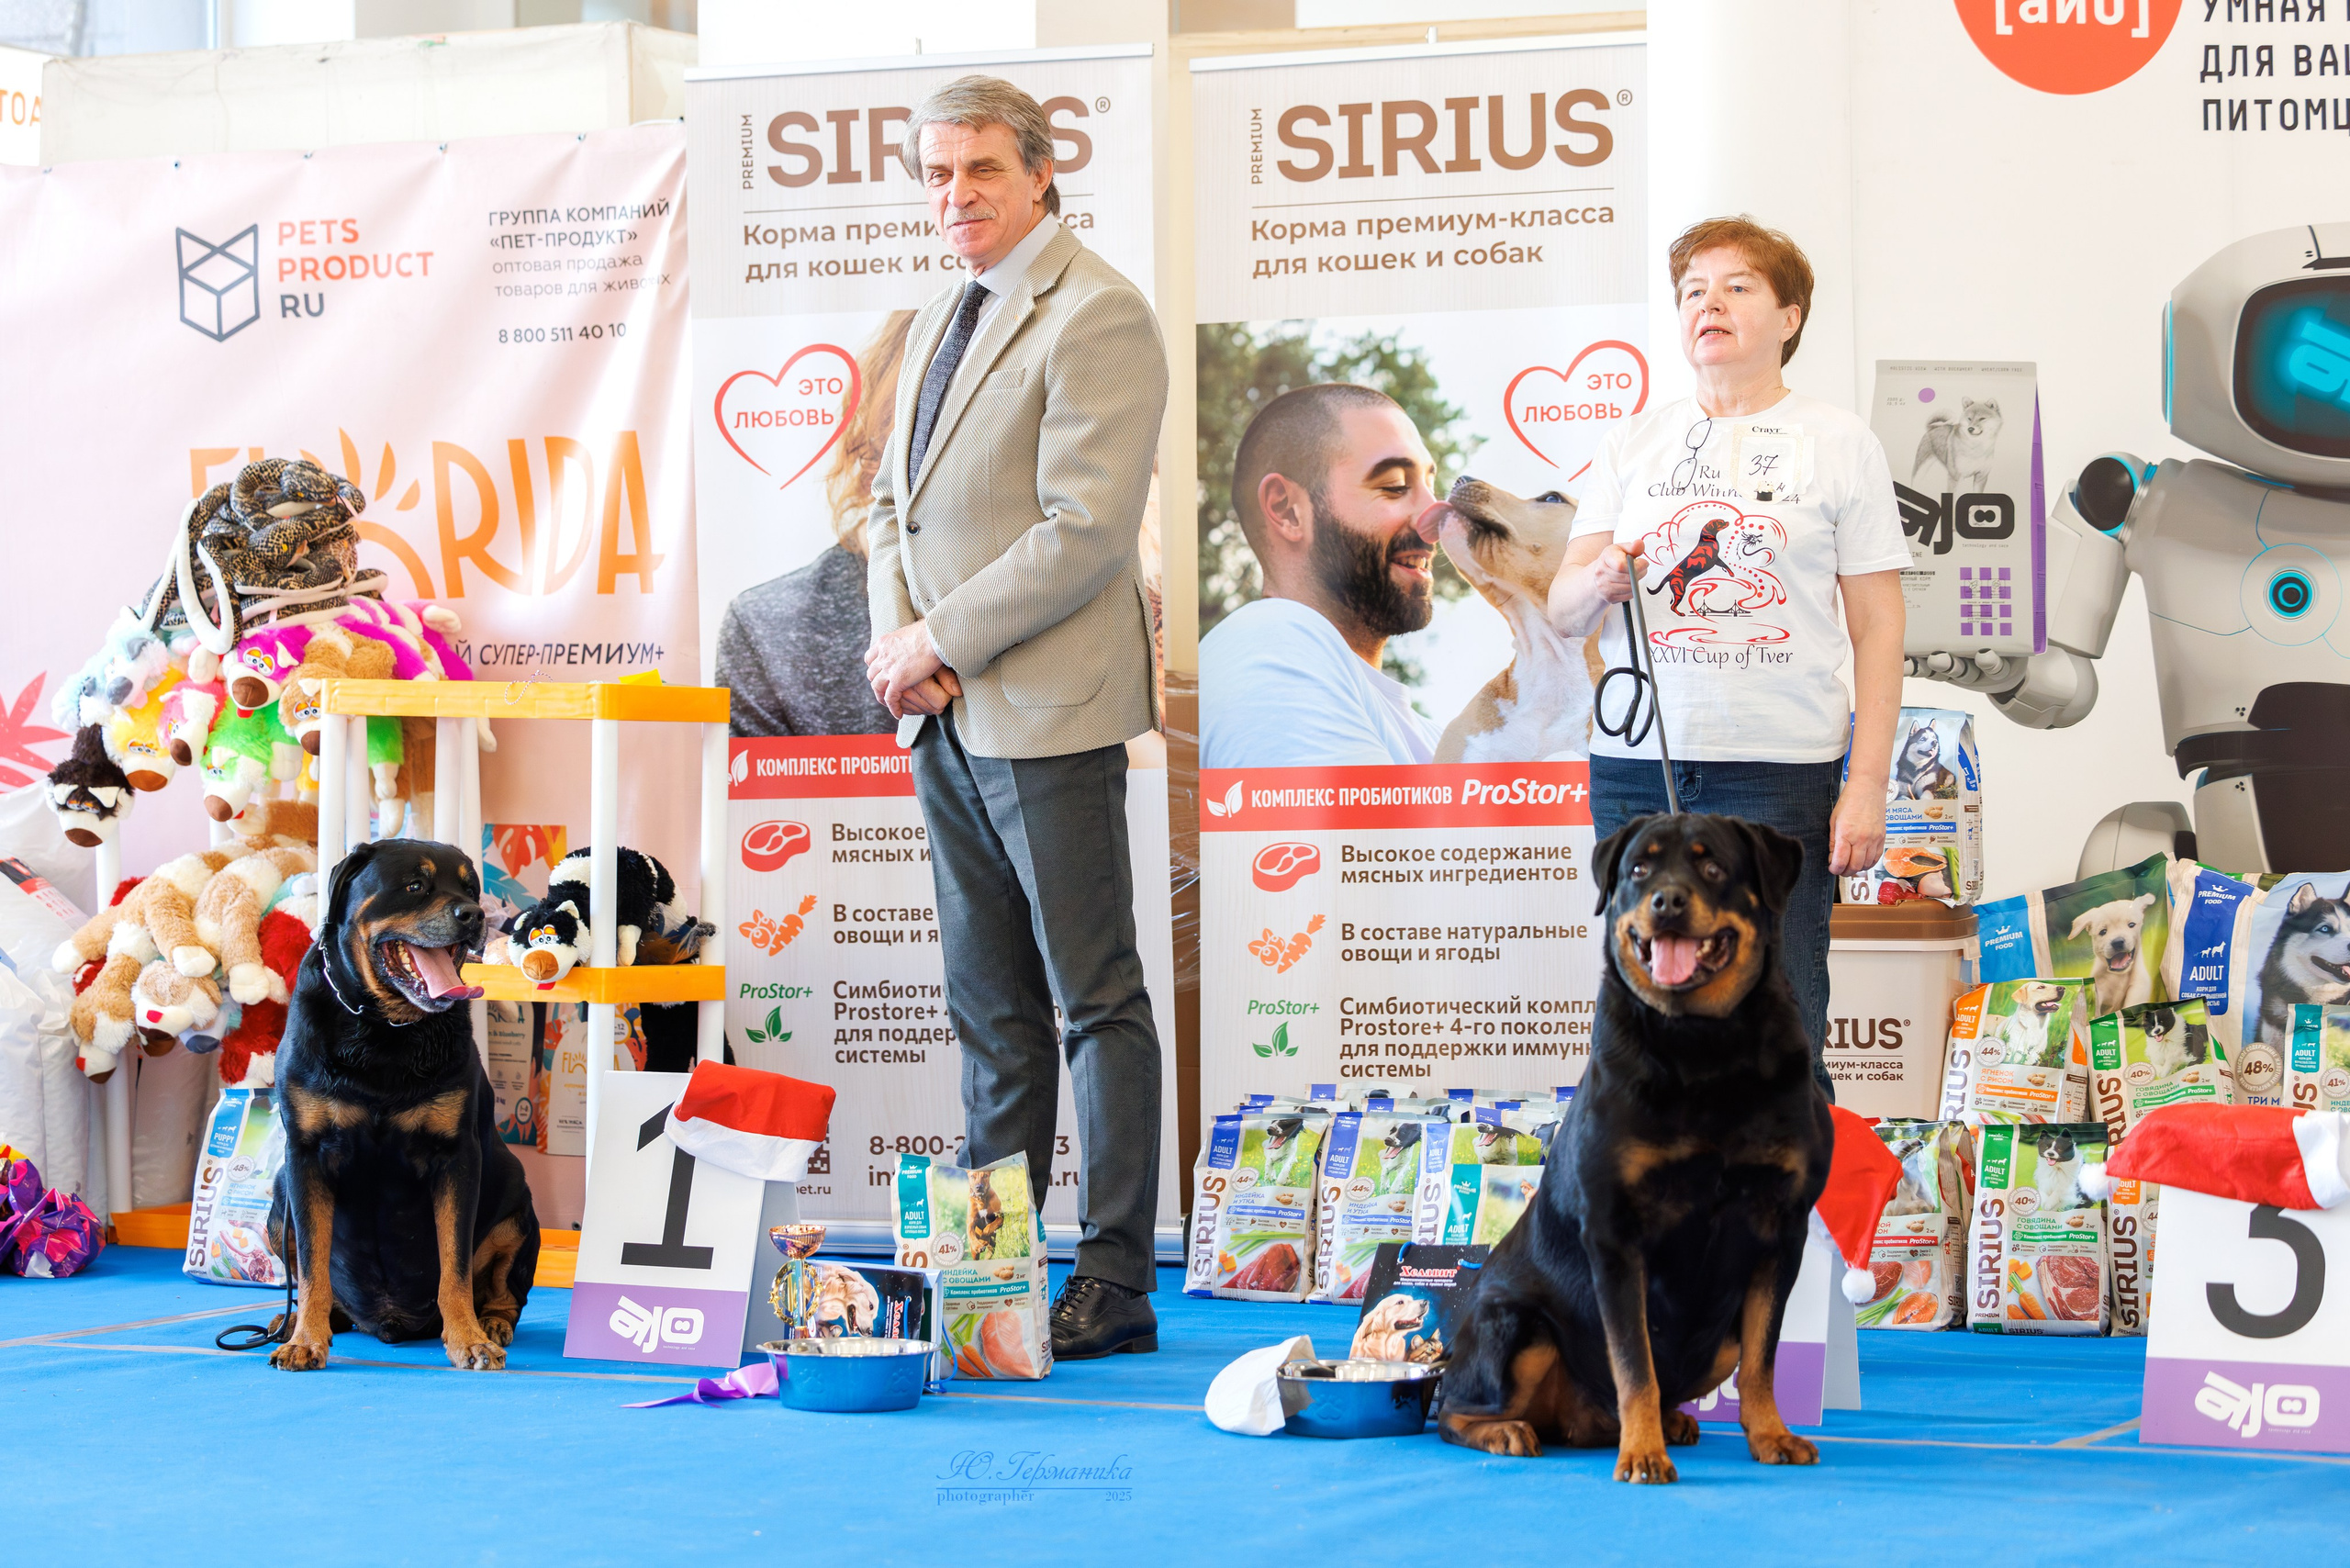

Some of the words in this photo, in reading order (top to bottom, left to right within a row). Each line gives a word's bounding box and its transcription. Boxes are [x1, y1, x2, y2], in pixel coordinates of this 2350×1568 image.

[2203, 0, 2327, 22] УМНАЯ
[2200, 44, 2275, 84] ДЛЯ
[1277, 89, 1614, 182] SIRIUS
[742, 114, 754, 189] PREMIUM
[1251, 108, 1262, 185] PREMIUM
[489, 208, 561, 226] ГРУППА
[566, 197, 670, 222] КОМПАНИЙ
[278, 218, 359, 246] PETS
[1251, 219, 1347, 244] Корма
[1357, 204, 1615, 241] премиум-класса
[490, 230, 637, 250] «ПЕТ-ПРОДУКТ»
[744, 225, 835, 249] Корма
[278, 252, 434, 283] PRODUCT
[493, 259, 562, 274] оптовая
[567, 254, 643, 271] продажа
[744, 262, 799, 284] для
[809, 257, 902, 278] кошек
[913, 255, 929, 273] и
[1252, 257, 1307, 279] для
[1318, 252, 1416, 274] кошек
[1427, 249, 1442, 267] и
[1454, 242, 1543, 266] собак
[495, 284, 563, 298] товаров
[567, 282, 598, 297] для
[280, 293, 325, 319] RU
[499, 330, 508, 343] 8
[513, 328, 545, 342] 800
[551, 327, 573, 342] 511
[579, 325, 603, 340] 40
[609, 323, 626, 338] 10
[799, 378, 843, 396] ЭТО
[1586, 374, 1632, 390] ЭТО
[734, 409, 834, 429] ЛЮБОВЬ
[1523, 402, 1622, 423] ЛЮБОВЬ
[1749, 454, 1778, 475] 37
[1648, 481, 1685, 497] Club
[1694, 483, 1742, 498] Winn
[480, 643, 665, 666] СУПЕР-ПРЕМИУМ+
[1693, 646, 1729, 669] Cup
[1736, 644, 1754, 669] of
[1756, 647, 1793, 663] Tver
[756, 756, 837, 777] КОМПЛЕКС
[841, 756, 912, 775] ПРОБИОТ
[1251, 789, 1334, 808] КОМПЛЕКС
[1339, 786, 1453, 806] ПРОБИОТИКОВ
[1460, 778, 1588, 806] ProStor+
[832, 823, 925, 841] Высокое
[832, 847, 913, 864] мясных
[1341, 845, 1435, 864] Высокое
[1441, 845, 1572, 865] содержание
[1341, 868, 1424, 884] мясных
[1429, 866, 1578, 886] ингредиентов
[2199, 890, 2236, 901] PREMIUM
[834, 903, 846, 923] В
[853, 908, 934, 923] составе
[834, 928, 903, 946] овощи
[910, 930, 921, 943] и
[1341, 924, 1355, 940] В
[1360, 927, 1442, 941] составе
[1448, 924, 1588, 945] натуральные
[1985, 931, 2023, 947] PREMIUM
[1341, 946, 1412, 964] овощи
[1418, 946, 1429, 960] и
[1435, 945, 1501, 963] ягоды
[1995, 941, 2013, 951] FOOD
[2189, 966, 2224, 981] ADULT
[740, 983, 813, 1000] ProStor+
[834, 980, 945, 1000] Симбиоти
[834, 1002, 938, 1021] Prostore+
[1248, 1000, 1319, 1015] ProStor+
[1339, 996, 1521, 1016] Симбиотический
[1527, 1000, 1596, 1018] компл
[834, 1028, 871, 1045] для
[878, 1028, 957, 1046] поддер
[1340, 1018, 1444, 1037] Prostore+
[1450, 1018, 1494, 1039] 4-го
[1501, 1021, 1591, 1036] поколен
[834, 1048, 926, 1064] системы
[1339, 1043, 1379, 1060] для
[1385, 1041, 1506, 1062] поддержки
[1981, 1047, 2001, 1056] 44%
[2295, 1049, 2315, 1058] ADULT
[1340, 1063, 1431, 1079] системы
[1824, 1059, 1903, 1070] миум-класса
[1982, 1068, 2014, 1077] ЯГНЕНОК
[2244, 1060, 2273, 1076] 48%
[1867, 1072, 1903, 1081] собак
[1987, 1076, 2013, 1084] РИСОМ
[2131, 1070, 2151, 1079] 40%
[2328, 1079, 2345, 1088] 41%
[2029, 1091, 2054, 1099] ProStor+
[2135, 1081, 2173, 1092] ГОВЯДИНА
[2143, 1083, 2180, 1097] ОВОЩАМИ
[2248, 1096, 2267, 1105] ТРИ
[214, 1132, 235, 1144] PUPPY
[1213, 1145, 1234, 1153] ADULT
[1330, 1154, 1349, 1163] ADULT
[233, 1163, 250, 1172] 48%
[1985, 1165, 2006, 1175] ADULT
[621, 1101, 714, 1270] 1
[2015, 1196, 2035, 1205] 40%
[189, 1166, 224, 1269] SIRIUS
[904, 1211, 924, 1220] ADULT
[1194, 1176, 1226, 1277] SIRIUS
[1448, 1223, 1469, 1234] ADULT
[1319, 1186, 1341, 1290] SIRIUS
[938, 1245, 957, 1254] 41%
[1977, 1198, 2005, 1309] SIRIUS
[1400, 1265, 1457, 1277] Хелавит
[2113, 1215, 2140, 1328] SIRIUS
[2206, 1205, 2325, 1338] 3
